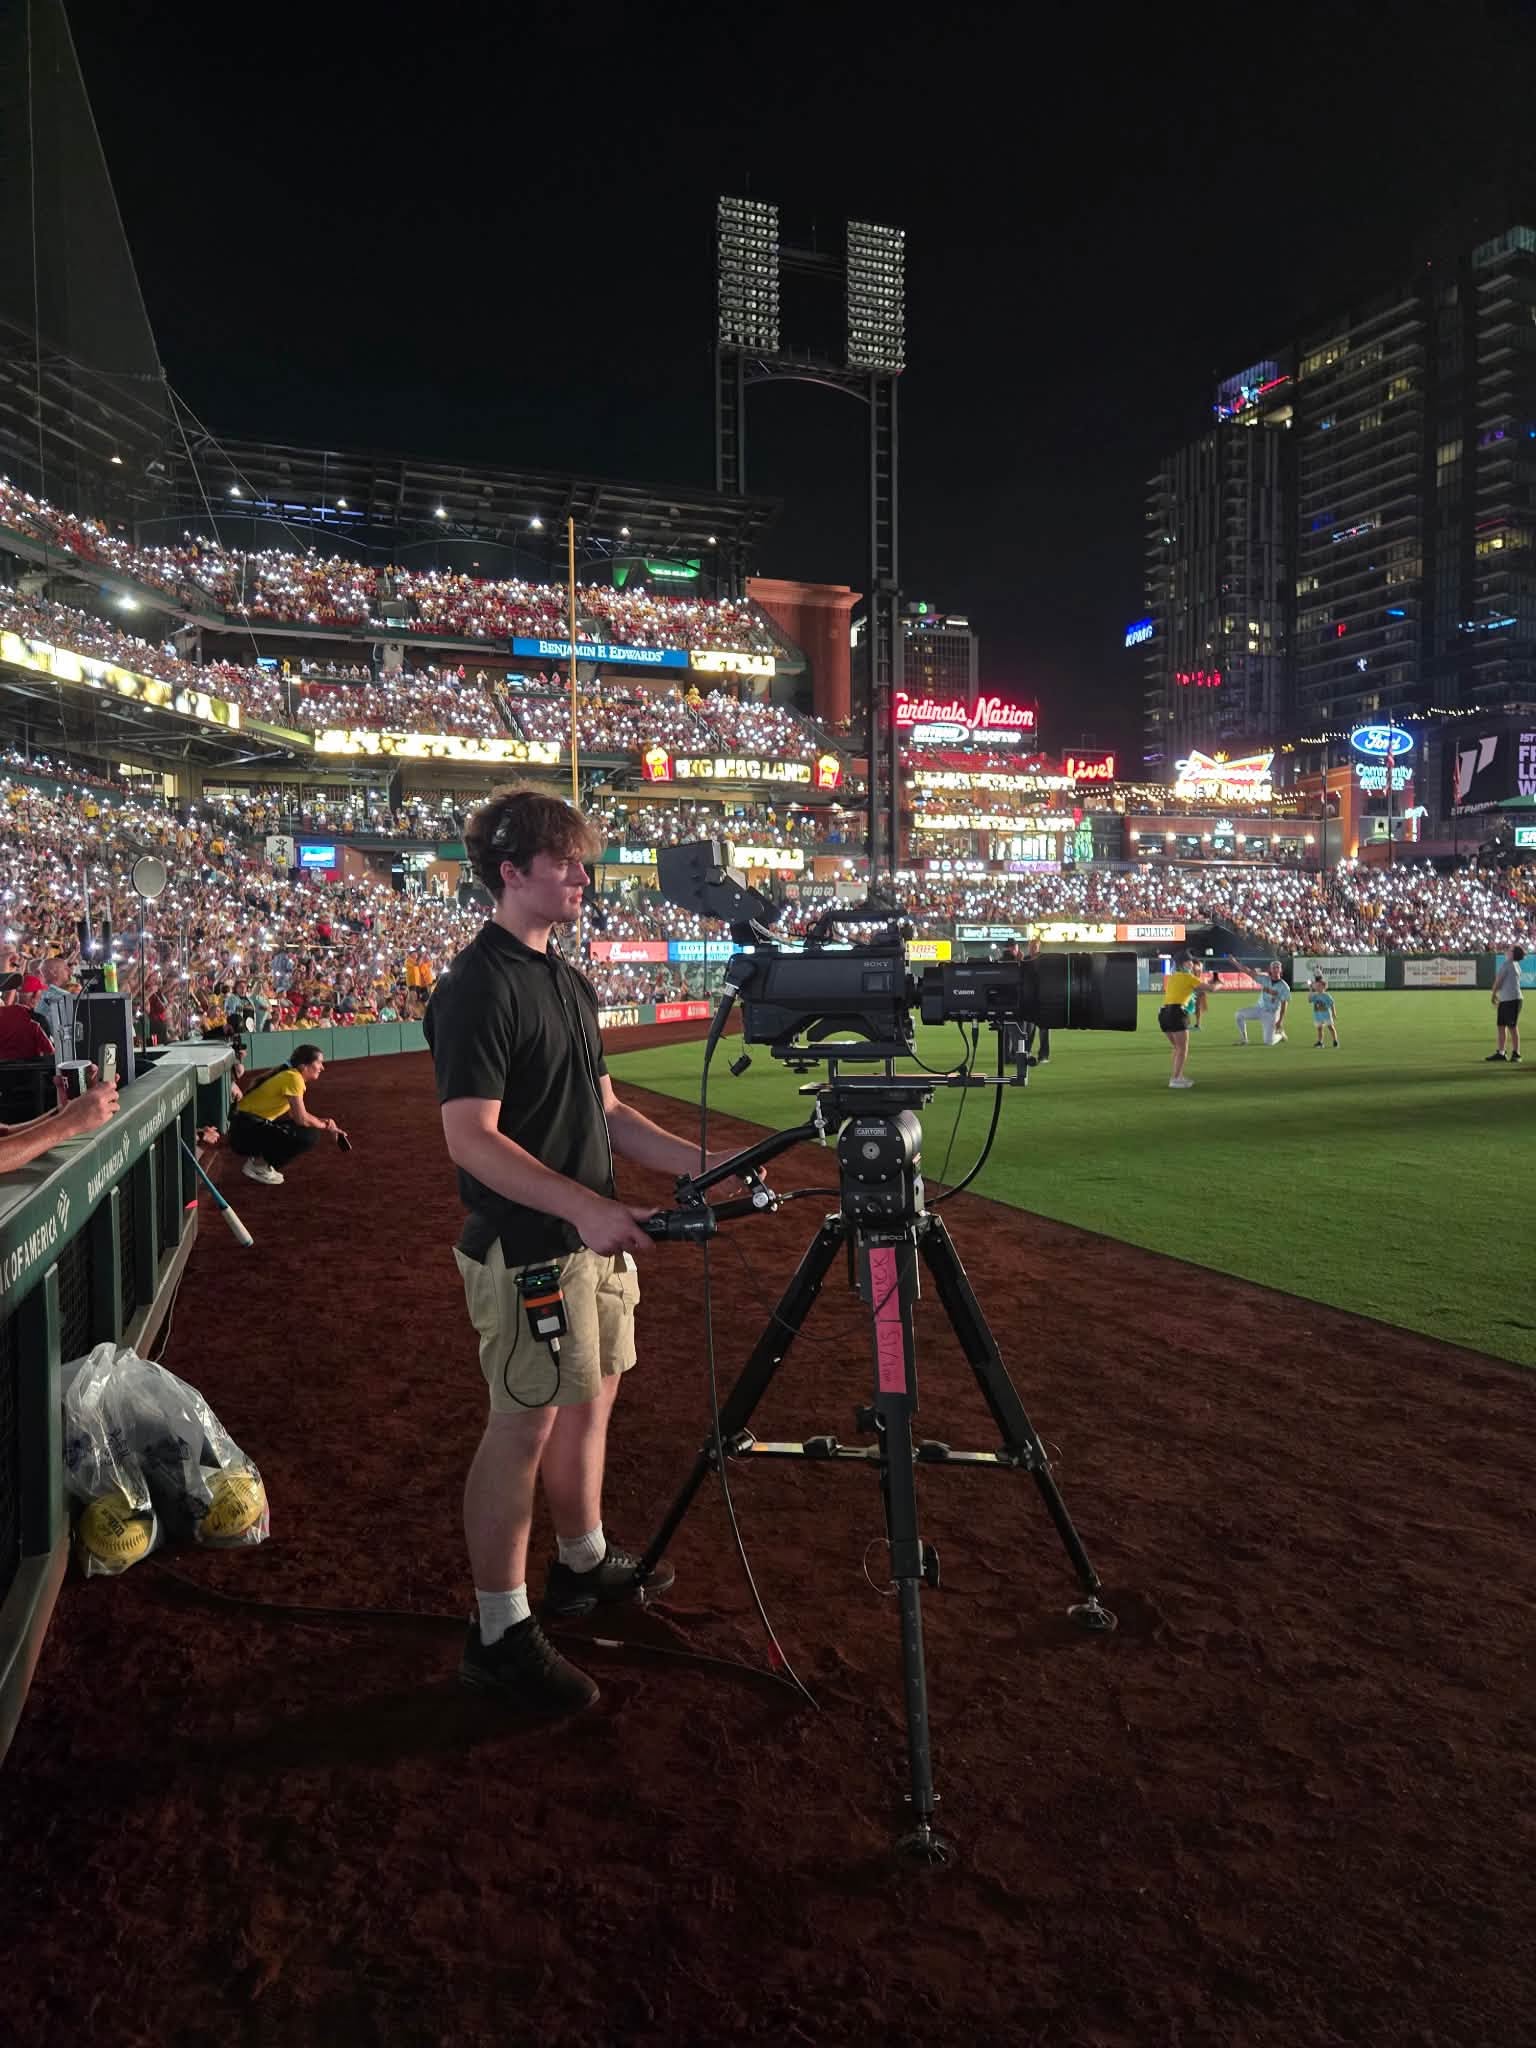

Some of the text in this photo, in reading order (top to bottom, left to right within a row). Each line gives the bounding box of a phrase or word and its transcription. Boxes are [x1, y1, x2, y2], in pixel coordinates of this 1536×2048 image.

[1125, 624, 1153, 648] KPMG
[609, 646, 663, 662] EDWARDS
[967, 697, 1034, 728] Nation
[675, 758, 811, 784] BIG MAC LAND
[1066, 756, 1114, 780] Live!
[1136, 927, 1175, 938] PURINA
[863, 960, 889, 968] SONY
[856, 1127, 885, 1137] CARTONI
[11, 1245, 23, 1282] OF
[24, 1213, 58, 1271] AMERICA
